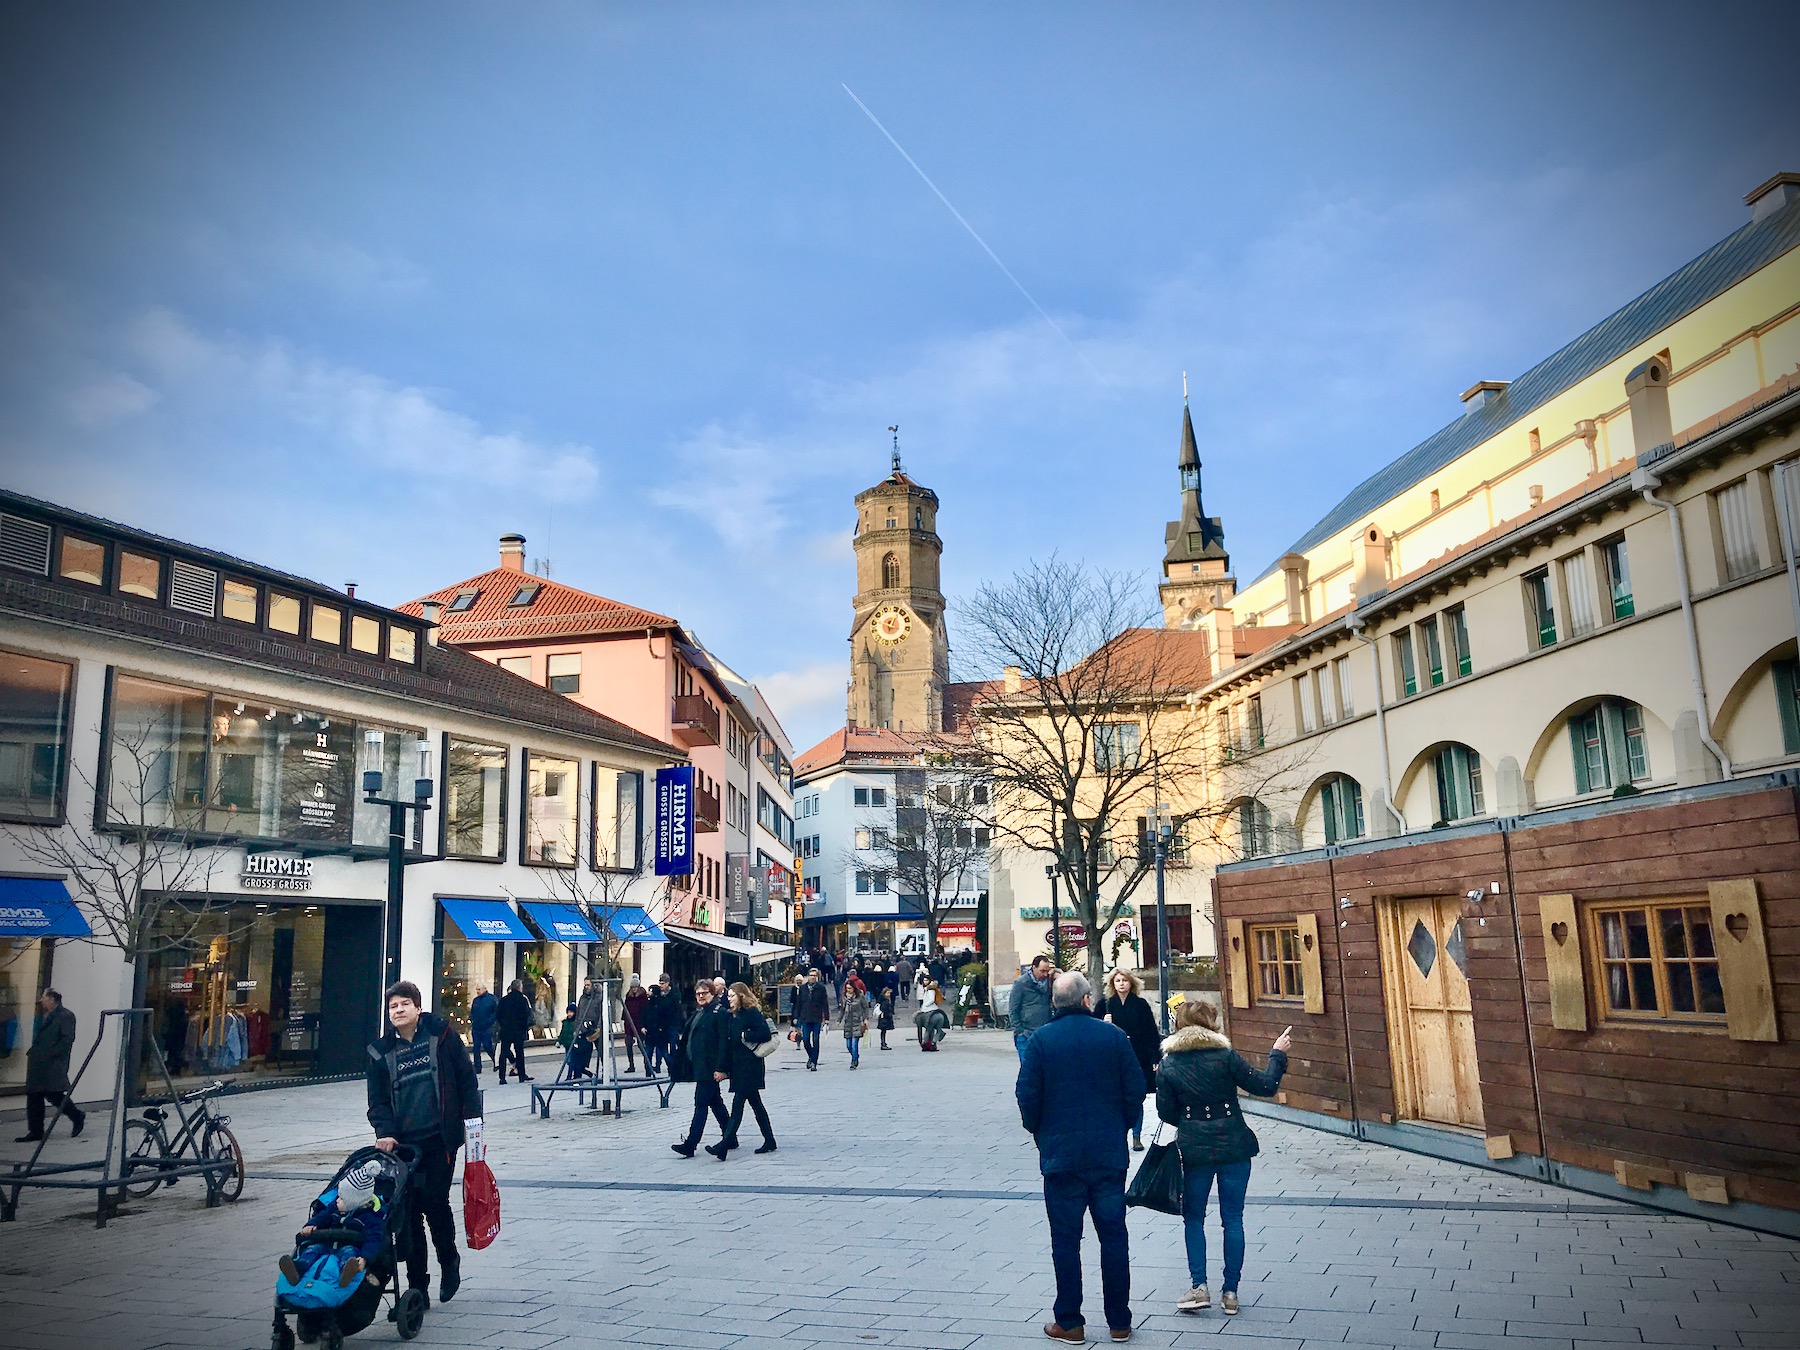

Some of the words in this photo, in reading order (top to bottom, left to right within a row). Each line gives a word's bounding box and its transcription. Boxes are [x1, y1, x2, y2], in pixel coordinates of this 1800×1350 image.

[673, 784, 686, 857] HIRMER
[660, 820, 668, 858] GRÖSSEN
[246, 854, 314, 876] HIRMER
[245, 878, 276, 889] GROSSE
[279, 878, 313, 890] GRÖSSEN
[734, 866, 742, 903] HERZOG
[473, 919, 508, 929] HIRMER
[959, 925, 976, 933] MÜLLE
